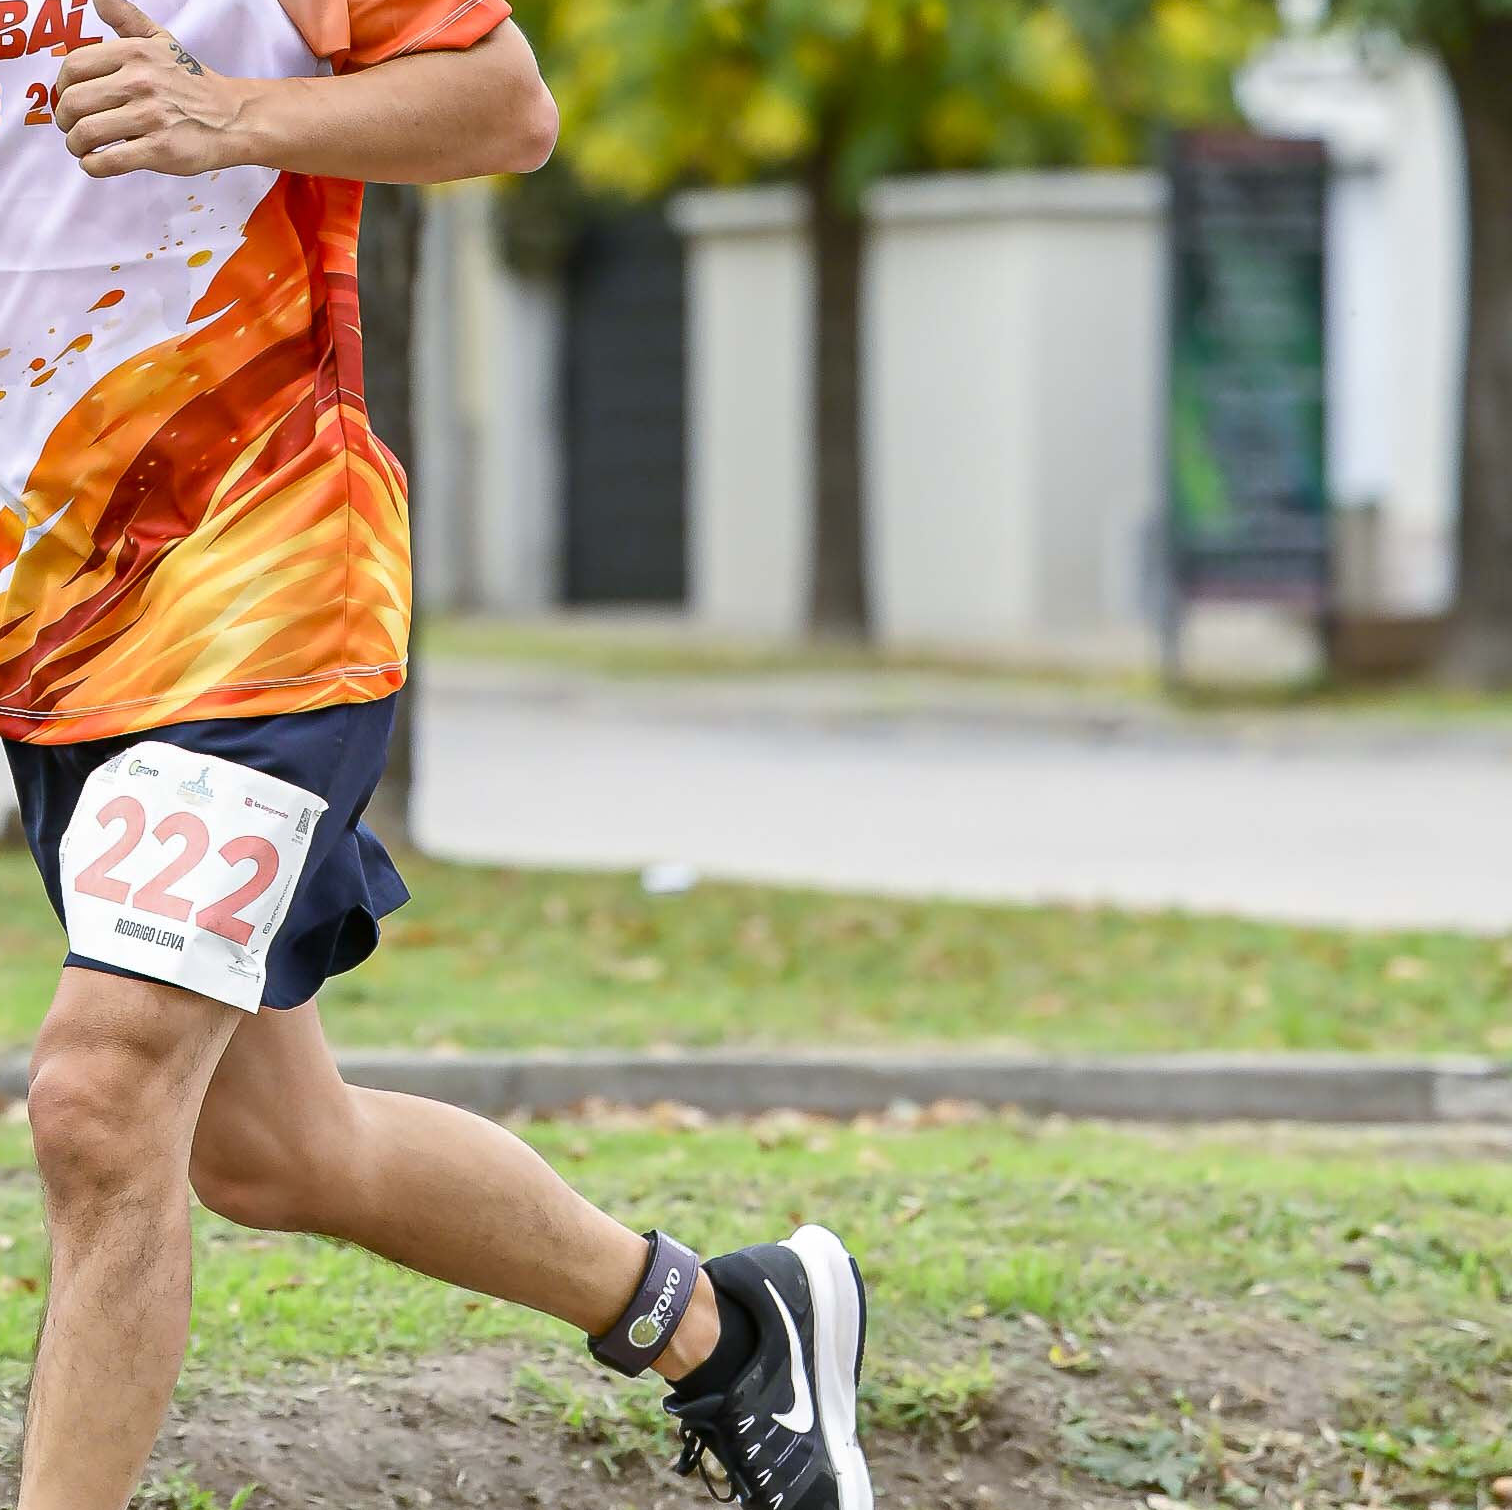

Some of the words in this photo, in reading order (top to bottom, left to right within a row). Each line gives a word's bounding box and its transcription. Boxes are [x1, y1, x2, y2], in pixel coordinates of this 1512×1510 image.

[75, 795, 280, 946] 222
[114, 917, 156, 943] RODRIGO
[156, 929, 185, 952] LEIVA
